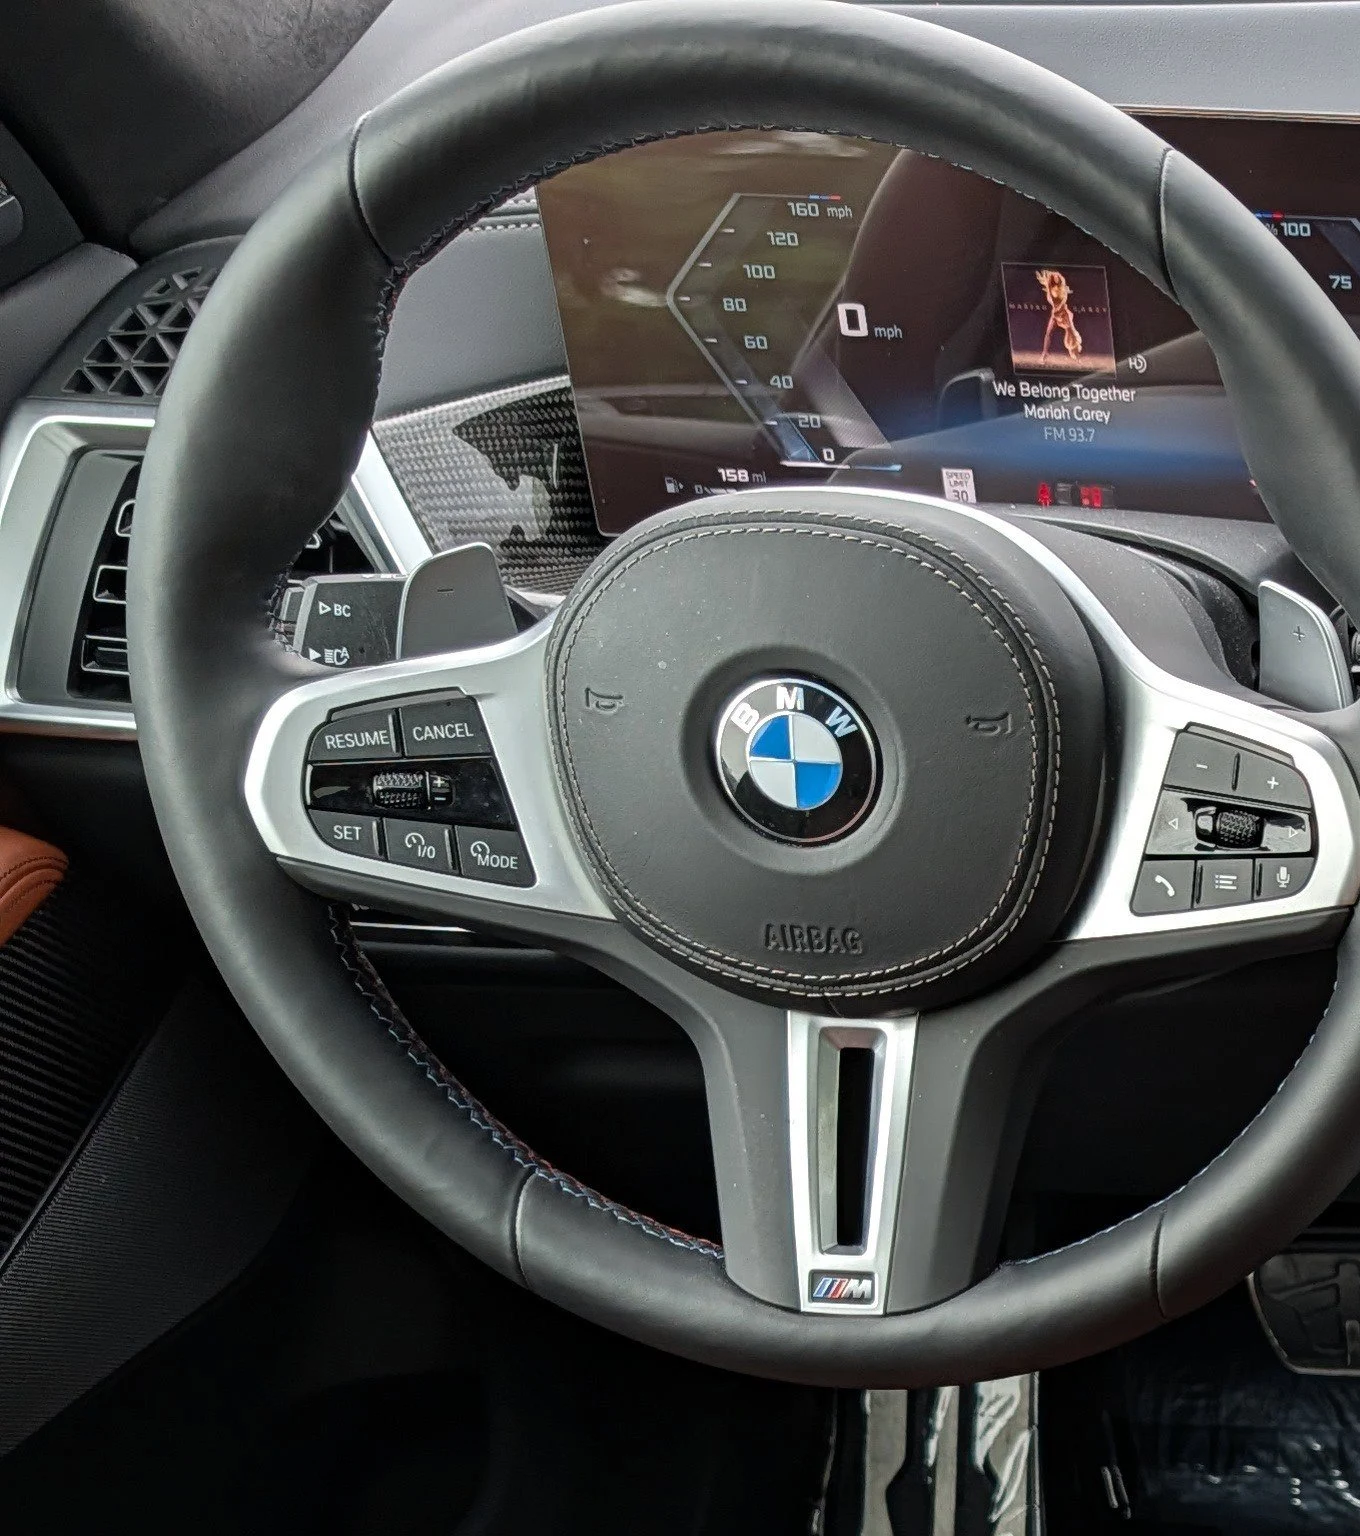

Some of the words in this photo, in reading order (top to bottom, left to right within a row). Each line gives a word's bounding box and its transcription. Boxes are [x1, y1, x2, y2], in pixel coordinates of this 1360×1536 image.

[787, 202, 820, 218] 160
[826, 206, 853, 219] mph
[1281, 222, 1311, 237] 100
[766, 231, 799, 247] 120
[743, 264, 776, 280] 100
[1328, 275, 1353, 290] 75
[722, 298, 748, 313] 80
[837, 302, 869, 338] 0
[874, 325, 903, 341] mph
[743, 335, 768, 350] 60
[769, 375, 794, 390] 40
[992, 380, 1016, 398] We
[1019, 381, 1071, 401] Belong
[1073, 383, 1137, 403] Together
[797, 414, 822, 430] 20
[1023, 403, 1071, 421] Mariah
[1073, 406, 1111, 425] Carey
[1043, 426, 1066, 442] FM
[1068, 427, 1096, 443] 93.7
[821, 448, 836, 463] 0
[717, 467, 750, 483] 158
[945, 470, 971, 481] SPEED
[949, 479, 969, 488] LIMIT
[952, 489, 970, 502] 30
[333, 603, 351, 618] BC
[730, 685, 858, 739] BMW
[324, 729, 390, 750] RESUME
[412, 722, 474, 742] CANCEL
[332, 825, 362, 841] SET
[476, 854, 519, 870] MODE
[764, 922, 863, 954] AIRBAG
